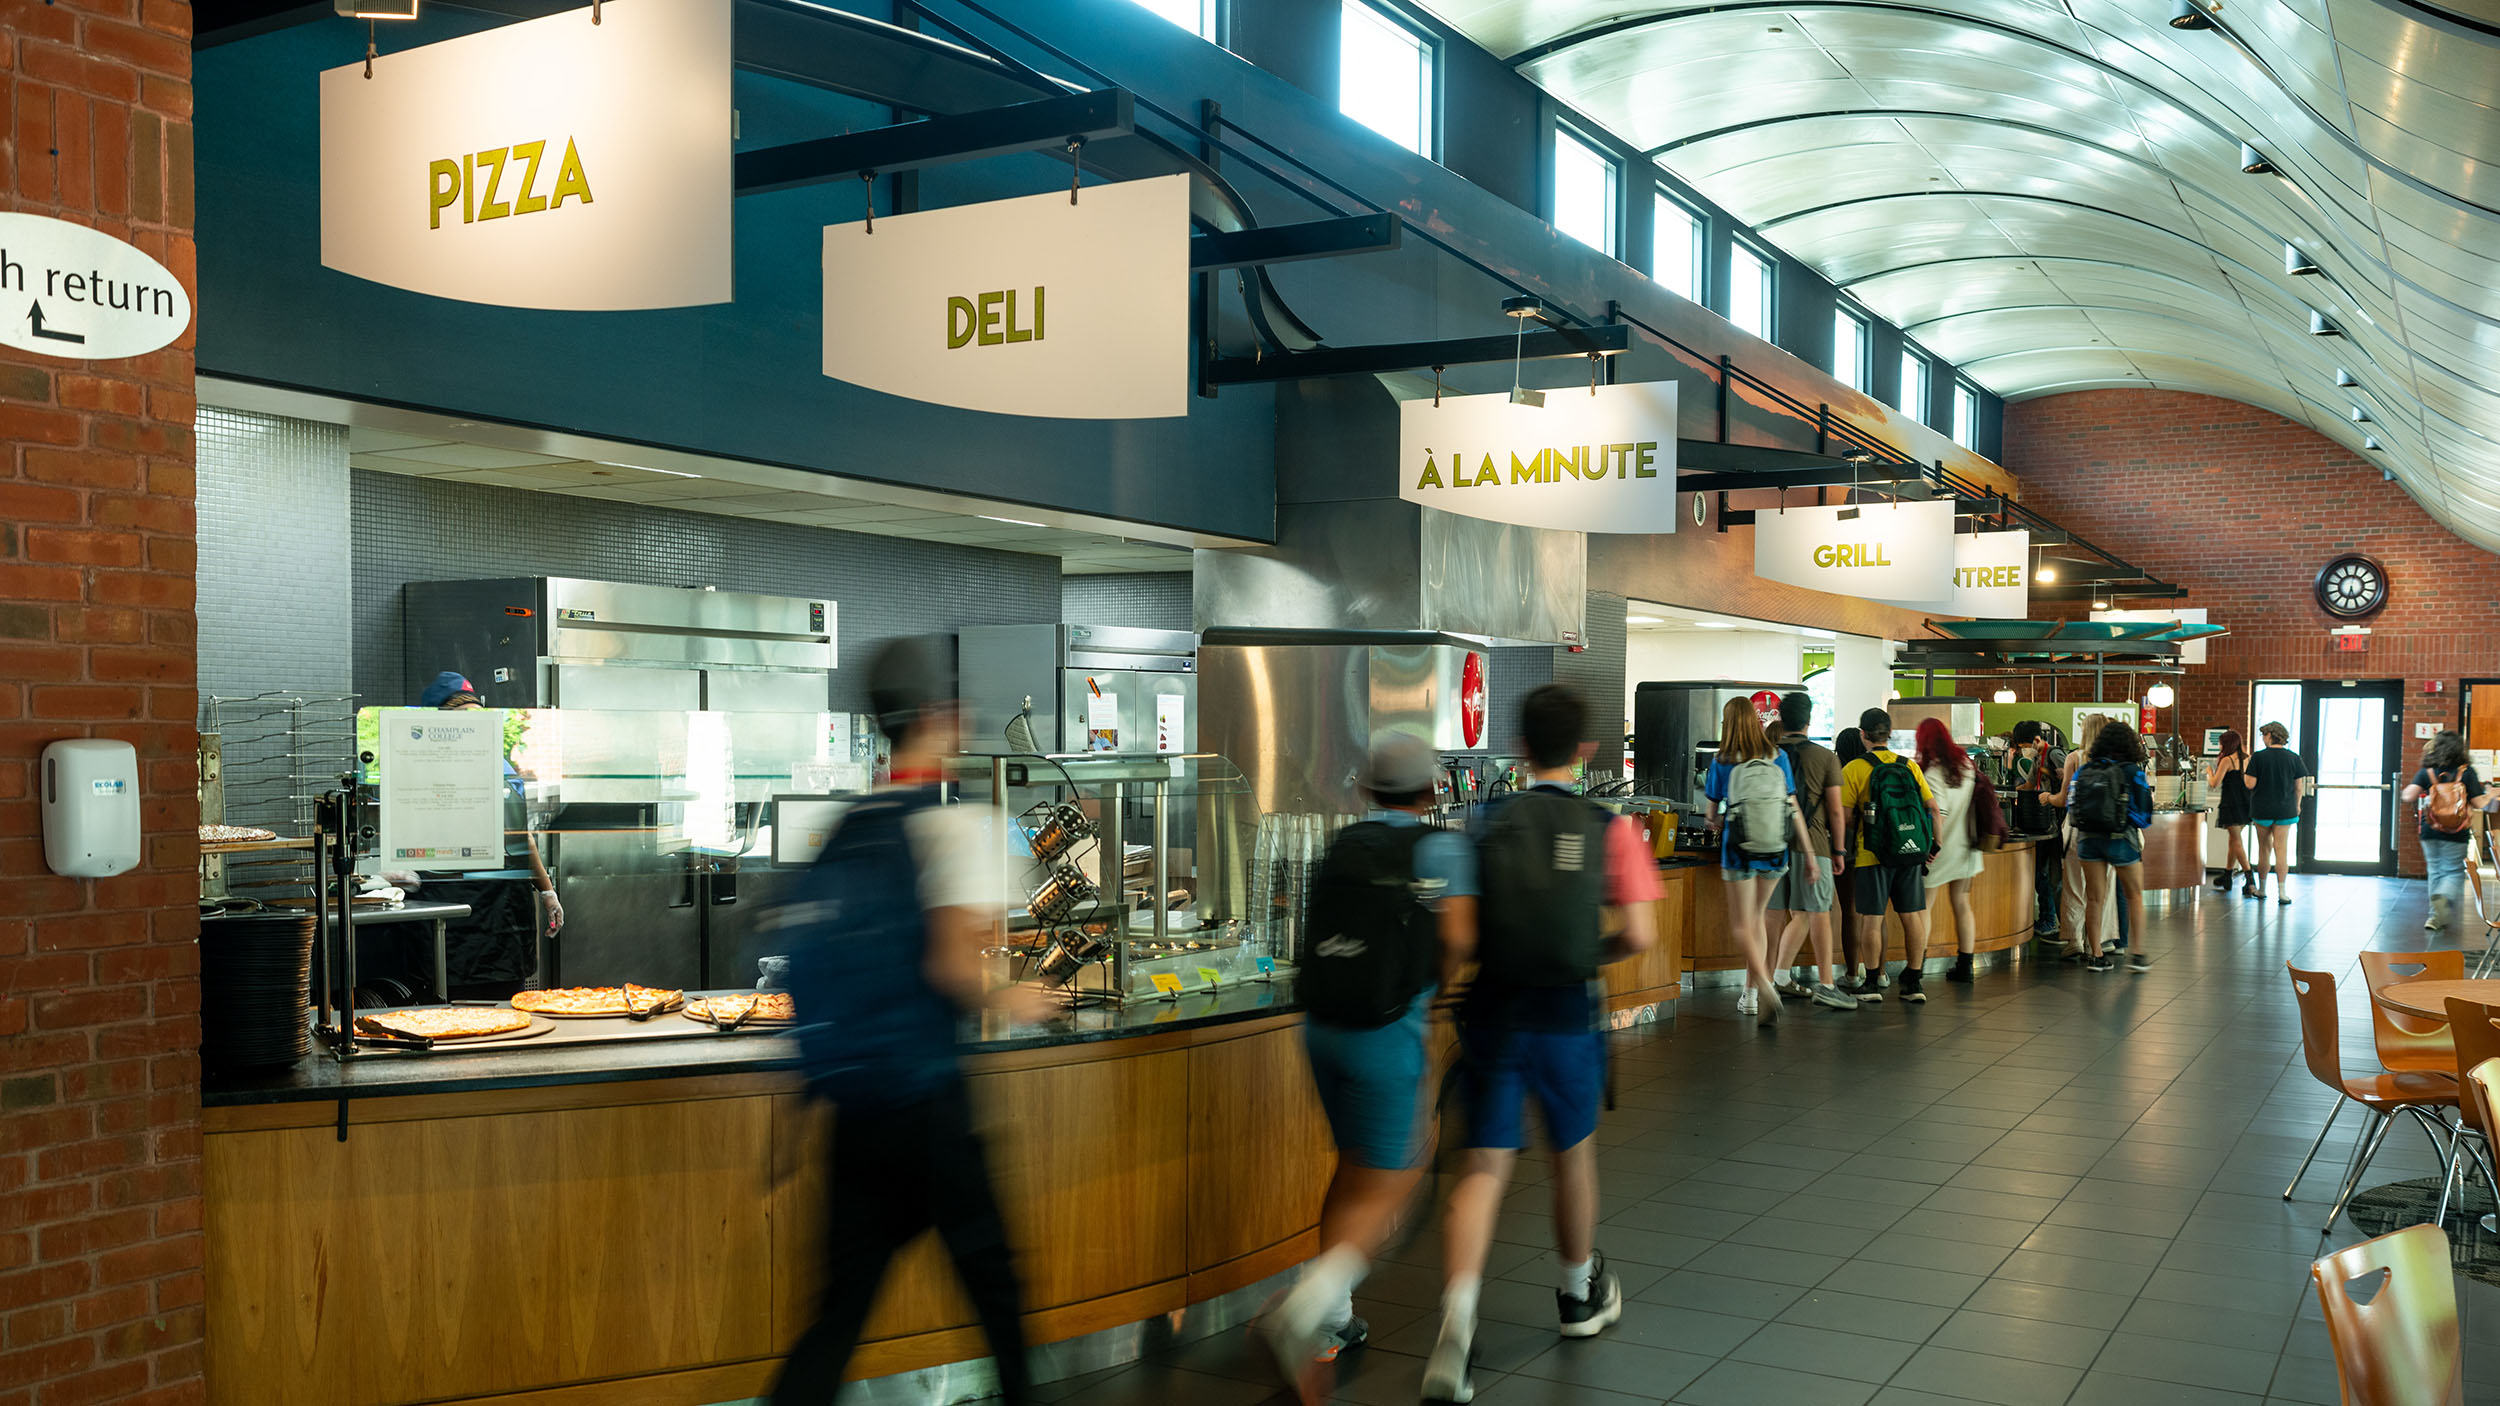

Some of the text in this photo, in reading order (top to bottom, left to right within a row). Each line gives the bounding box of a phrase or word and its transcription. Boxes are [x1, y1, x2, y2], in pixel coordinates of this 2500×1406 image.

[429, 135, 594, 230] PIZZA
[46, 268, 174, 318] return
[947, 285, 1045, 350] DELI
[1416, 441, 1657, 490] À LA MINUTE
[1813, 542, 1891, 568] GRILL
